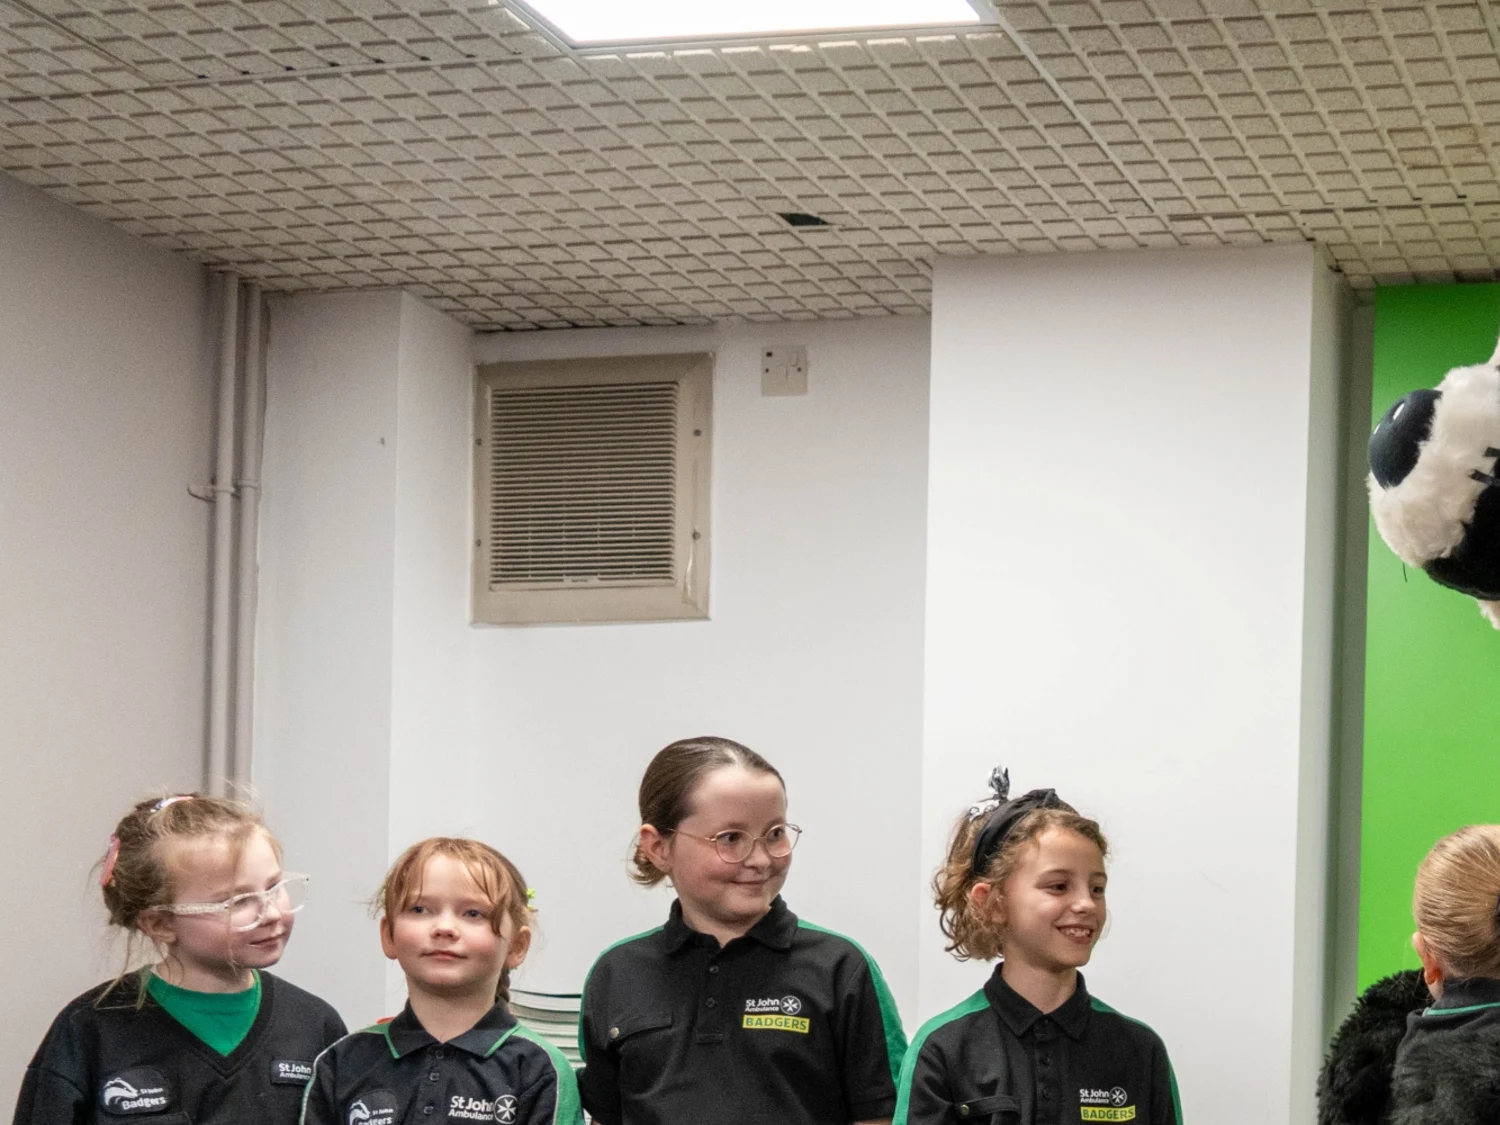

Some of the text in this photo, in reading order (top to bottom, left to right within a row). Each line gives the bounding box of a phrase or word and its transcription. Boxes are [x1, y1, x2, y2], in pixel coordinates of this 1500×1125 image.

[745, 998, 780, 1007] St John
[745, 1017, 807, 1031] BADGERS
[278, 1063, 312, 1074] St John
[1080, 1088, 1110, 1098] St John
[121, 1096, 167, 1111] Badgers
[450, 1095, 494, 1112] St John
[1082, 1107, 1135, 1120] BADGERS
